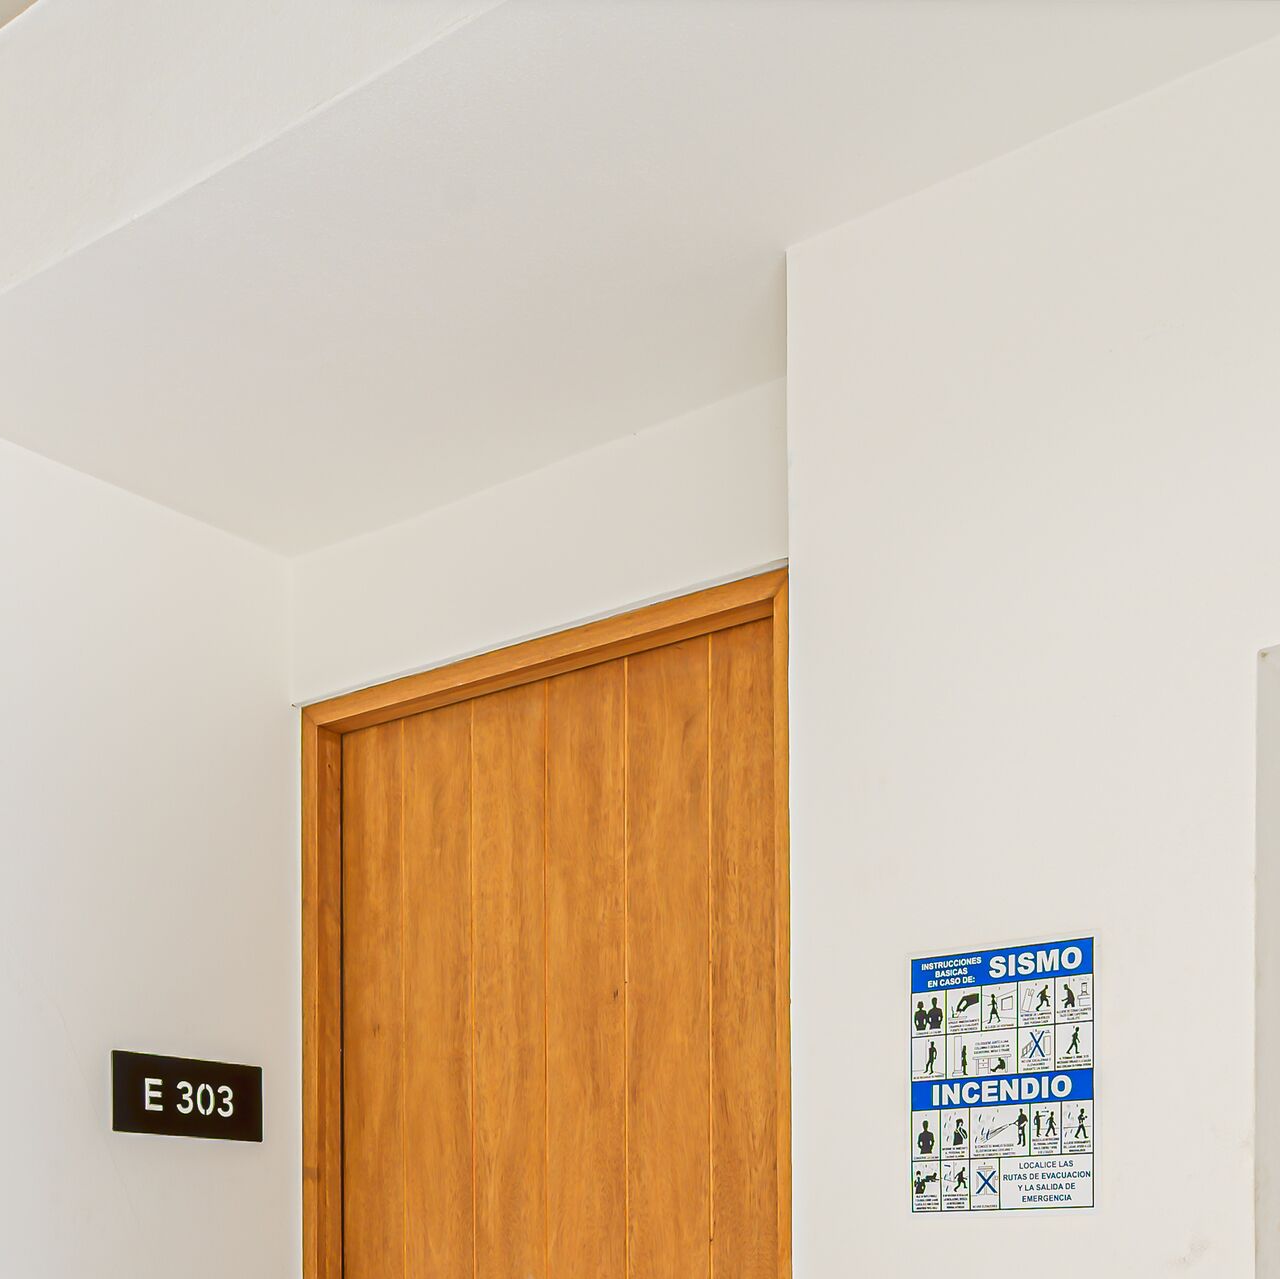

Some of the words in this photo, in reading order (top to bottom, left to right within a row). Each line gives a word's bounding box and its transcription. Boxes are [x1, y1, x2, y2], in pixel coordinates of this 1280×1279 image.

[921, 956, 982, 971] INSTRUCCIONES
[988, 946, 1083, 979] SISMO
[934, 967, 968, 978] BASICAS
[927, 980, 938, 988] EN
[939, 977, 961, 986] CASO
[962, 975, 976, 984] DE:
[144, 1077, 163, 1112] E
[176, 1080, 234, 1117] 303
[932, 1077, 1072, 1107] INCENDIO
[1018, 1161, 1057, 1169] LOCALICE
[1002, 1173, 1028, 1181] RUTAS
[1041, 1170, 1091, 1180] EVACUACION
[1036, 1183, 1064, 1191] SALIDA
[1065, 1182, 1076, 1190] DE
[1021, 1194, 1072, 1202] EMERGENCIA
